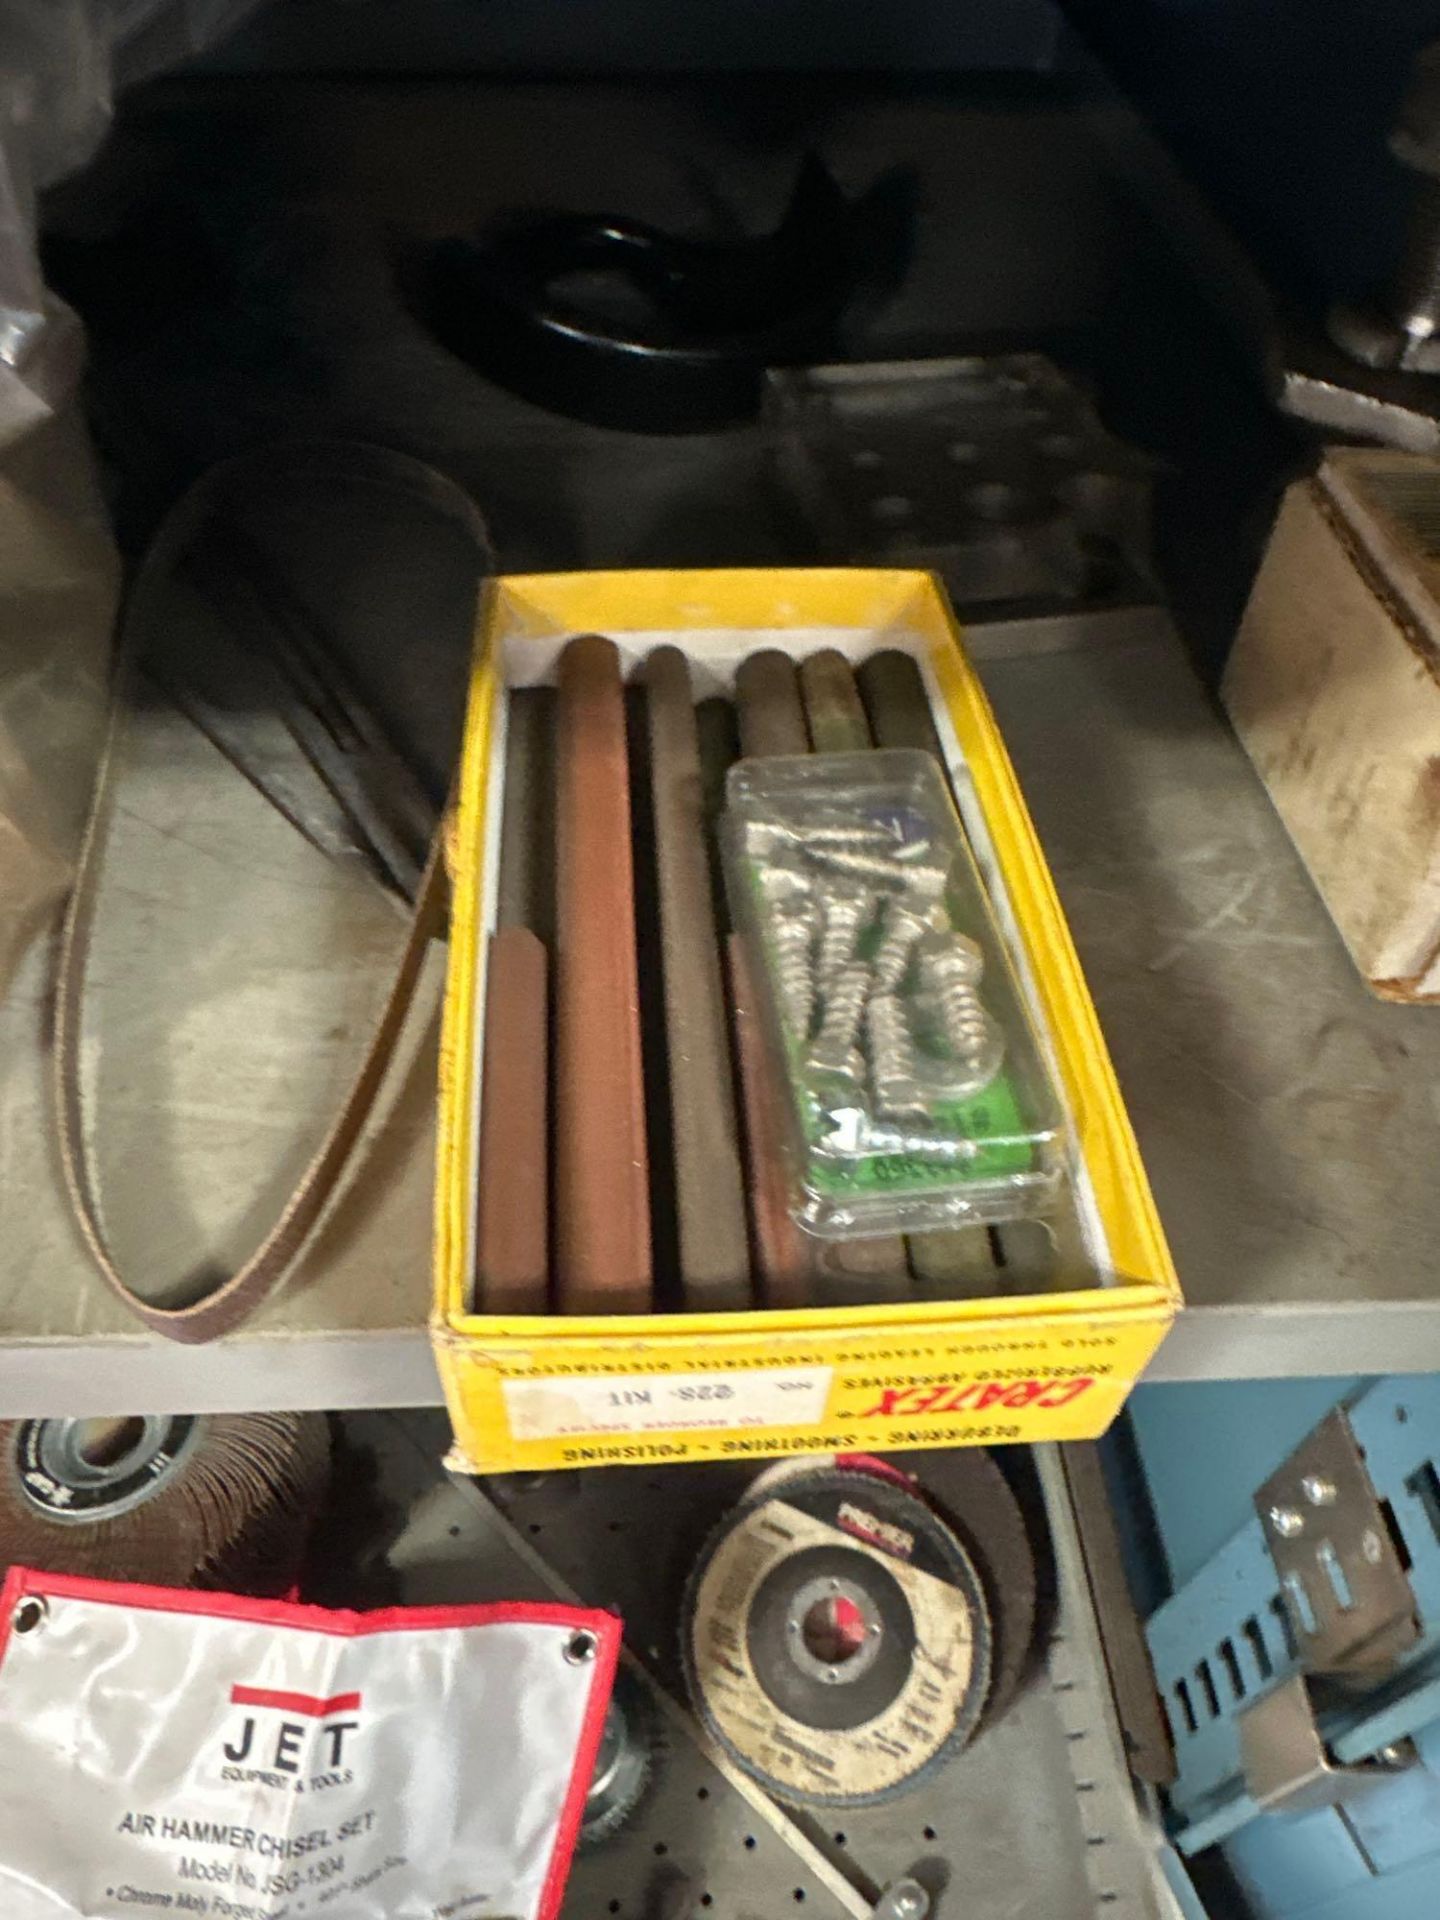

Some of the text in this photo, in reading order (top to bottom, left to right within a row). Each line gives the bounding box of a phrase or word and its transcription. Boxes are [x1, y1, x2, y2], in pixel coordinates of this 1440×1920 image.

[609, 1389, 652, 1406] KIT
[857, 1376, 1096, 1419] CRATEX
[563, 1425, 1021, 1462] DEBURRING SMOOTHING POLISHING
[223, 1717, 359, 1773] JET
[221, 1766, 288, 1791] EQUIPMENT
[310, 1770, 353, 1792] TOOLS
[118, 1809, 376, 1860] AIR HAMMER CHISEL SET
[178, 1856, 231, 1884] Model
